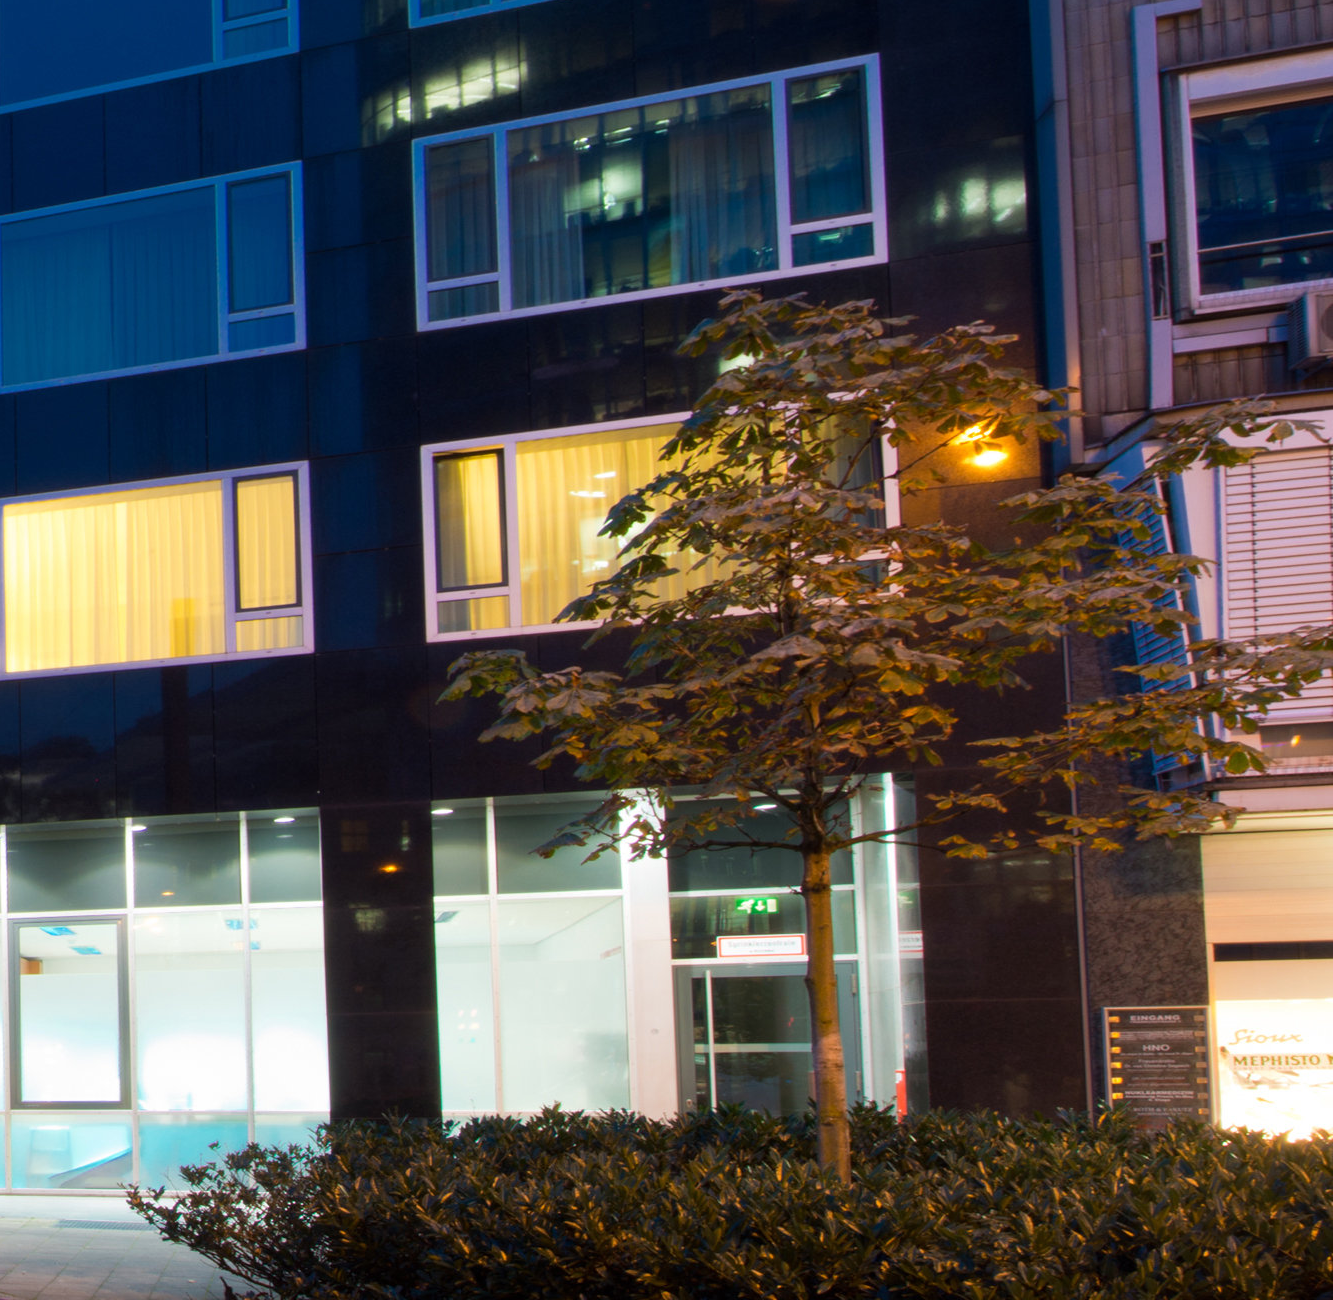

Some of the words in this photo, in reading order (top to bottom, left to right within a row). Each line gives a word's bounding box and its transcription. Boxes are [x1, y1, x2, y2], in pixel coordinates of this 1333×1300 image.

[1228, 1029, 1303, 1045] Sioux
[1142, 1044, 1171, 1052] HNO
[1233, 1055, 1321, 1066] MEPHISTO
